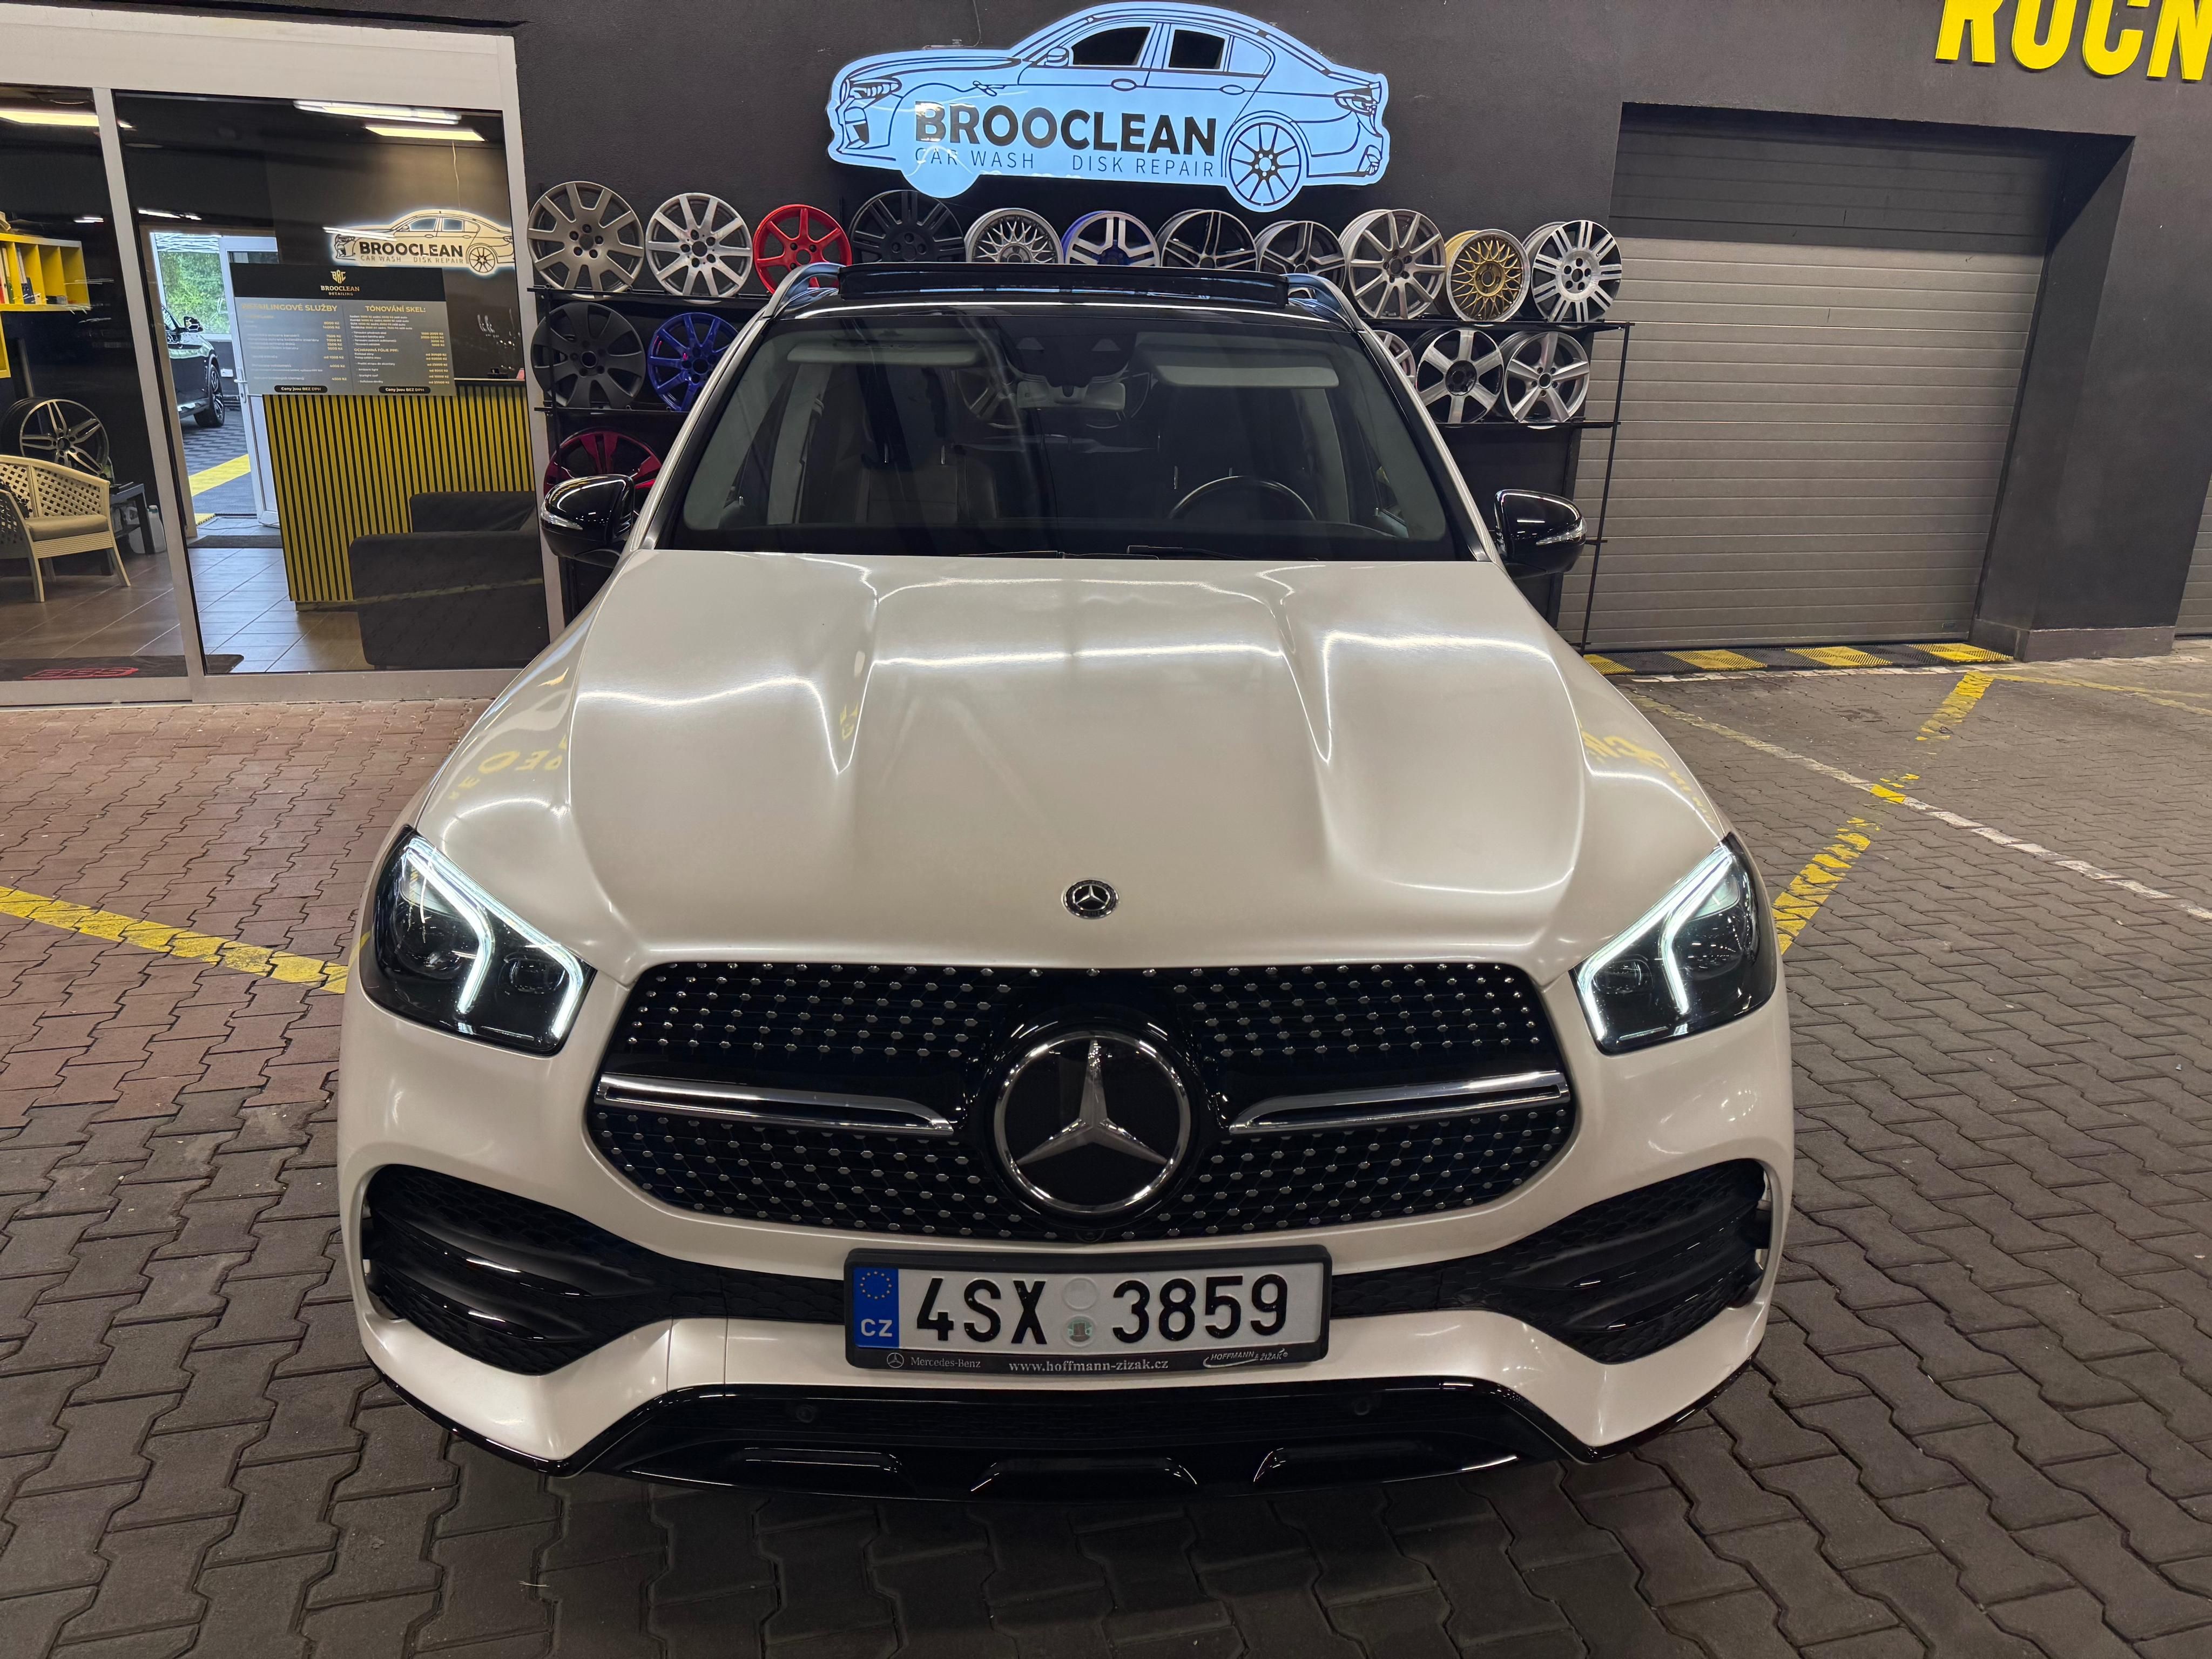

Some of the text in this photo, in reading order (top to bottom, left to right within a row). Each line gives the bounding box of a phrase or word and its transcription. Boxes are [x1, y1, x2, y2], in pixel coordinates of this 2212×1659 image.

[915, 101, 1216, 156] BROOCLEAN
[915, 147, 1214, 177] CAR WASH DISK REPAIR
[359, 241, 463, 257] BROOCLEAN
[305, 303, 338, 312] SLUŽBY
[917, 1274, 1288, 1344] 4SX 3859
[860, 1319, 893, 1337] CZ
[911, 1357, 981, 1368] Mercedes-Benz
[1210, 1351, 1255, 1360] HOFFMANN
[1009, 1359, 1169, 1372] www.hoffmann-zizak.cz
